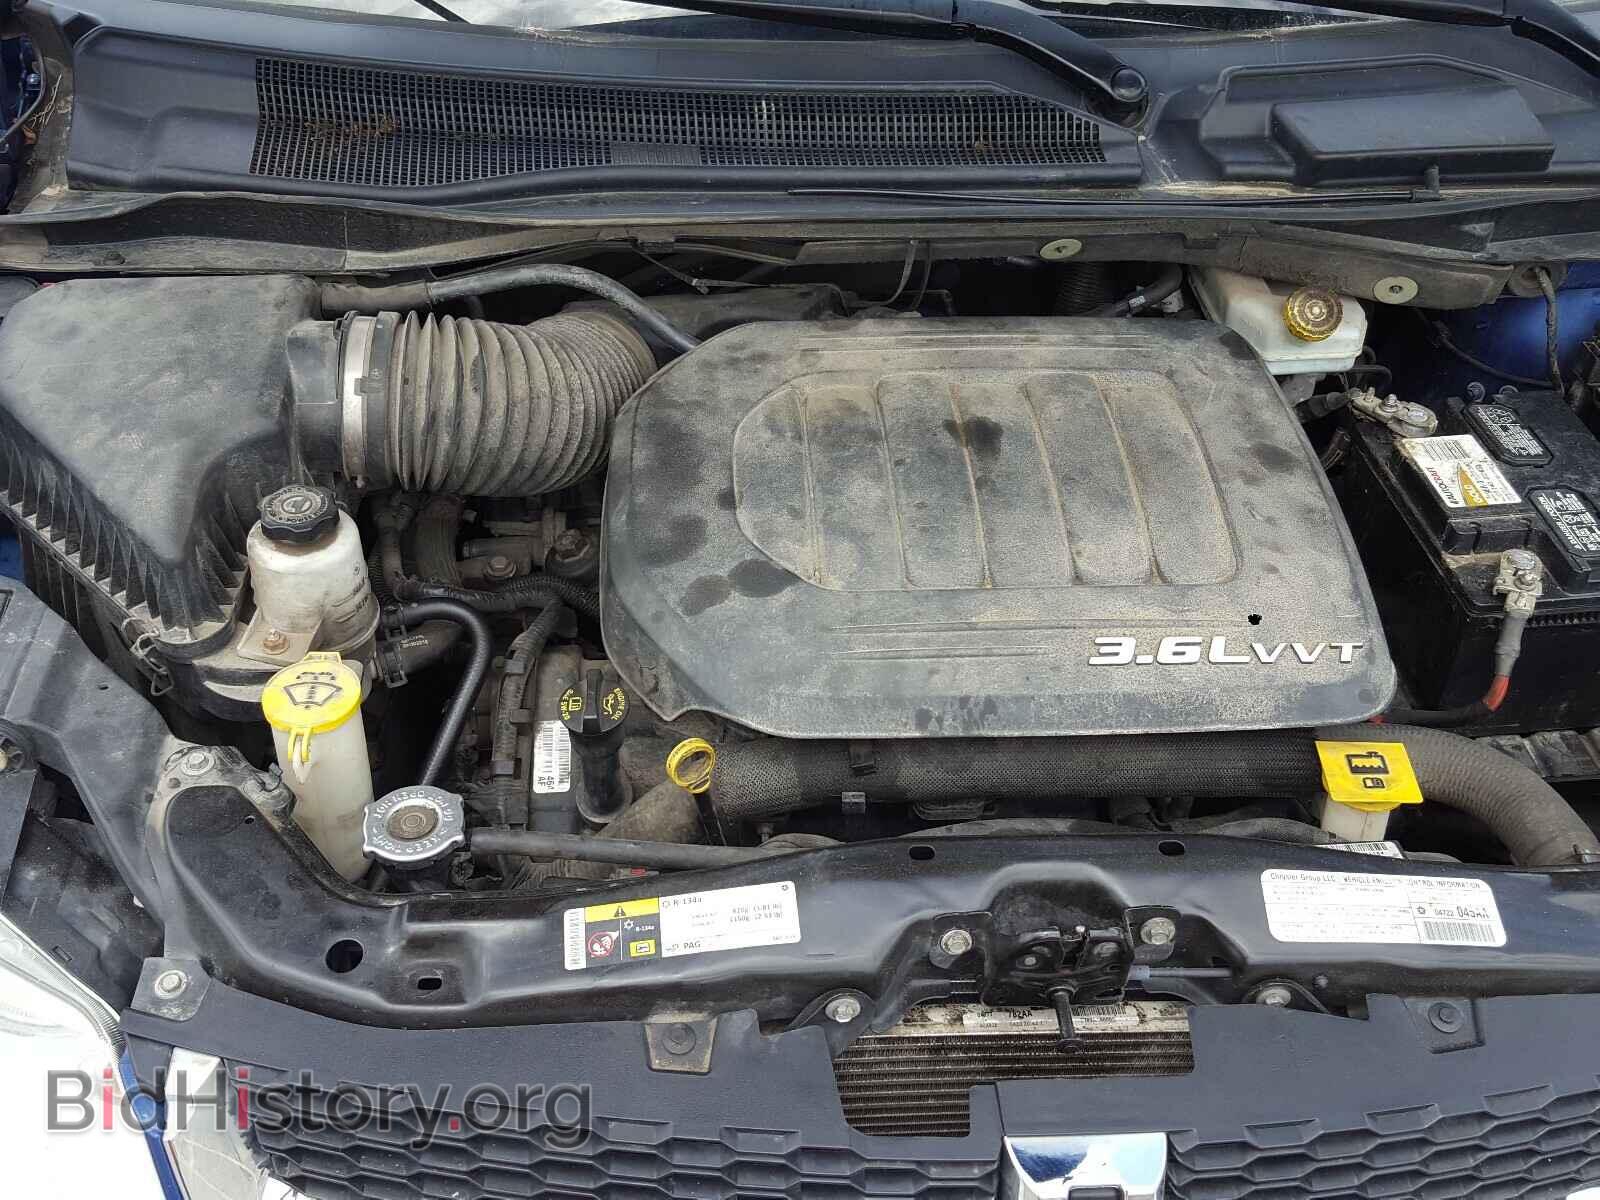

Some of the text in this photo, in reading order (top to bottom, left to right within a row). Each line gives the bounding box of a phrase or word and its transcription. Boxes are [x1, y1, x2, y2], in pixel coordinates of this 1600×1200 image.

[1088, 636, 1364, 666] 3.6L VVT
[610, 687, 625, 721] ENGINE OIL
